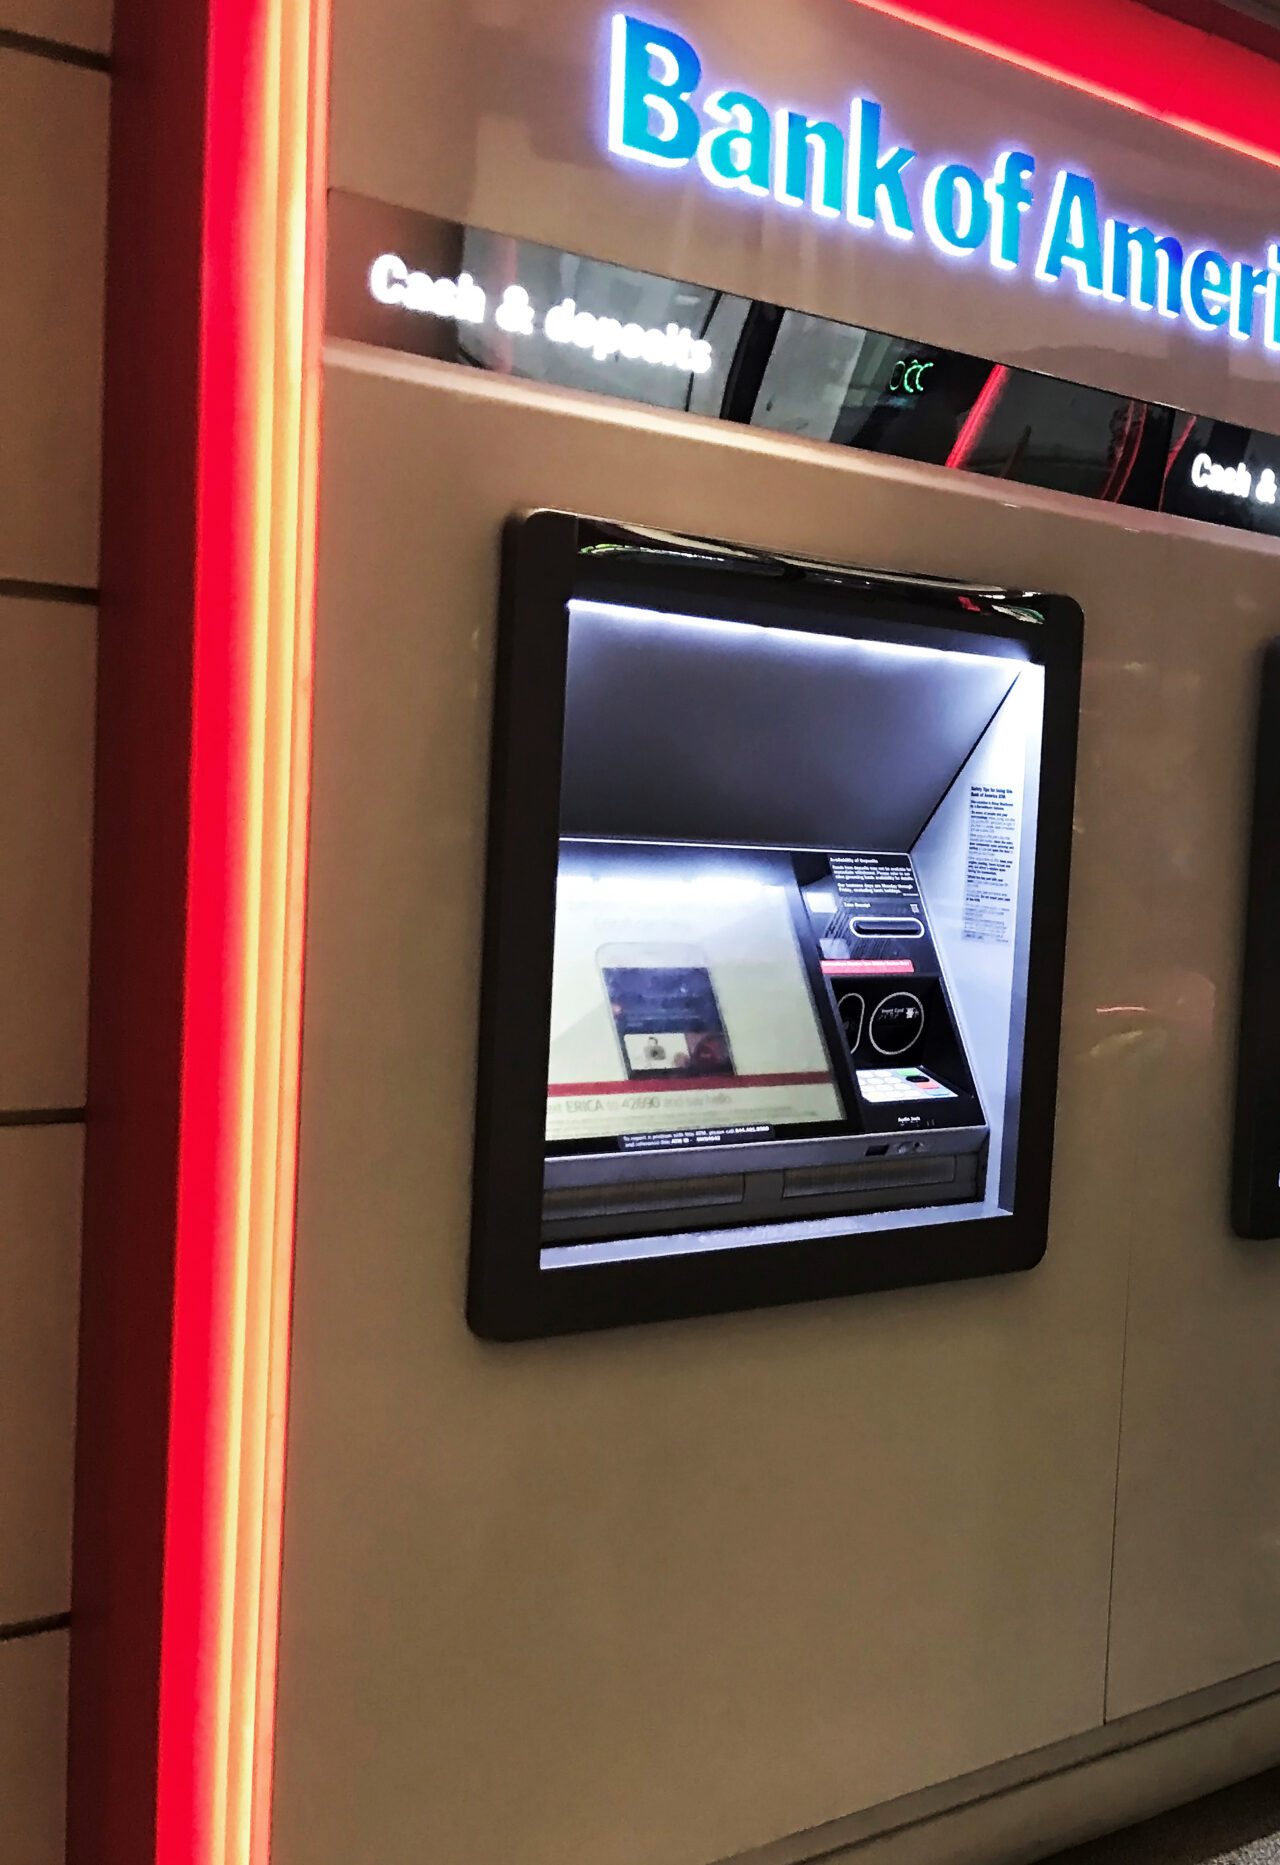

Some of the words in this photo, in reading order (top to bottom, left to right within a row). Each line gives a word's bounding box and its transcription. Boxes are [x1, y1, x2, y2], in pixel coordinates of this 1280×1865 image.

[606, 12, 918, 241] Bank
[922, 149, 1035, 270] of
[369, 254, 486, 324] Cash
[495, 285, 536, 335] &
[545, 298, 712, 374] deposits
[1191, 453, 1252, 498] Cash
[1255, 468, 1278, 505] &
[566, 1099, 604, 1114] ERICA
